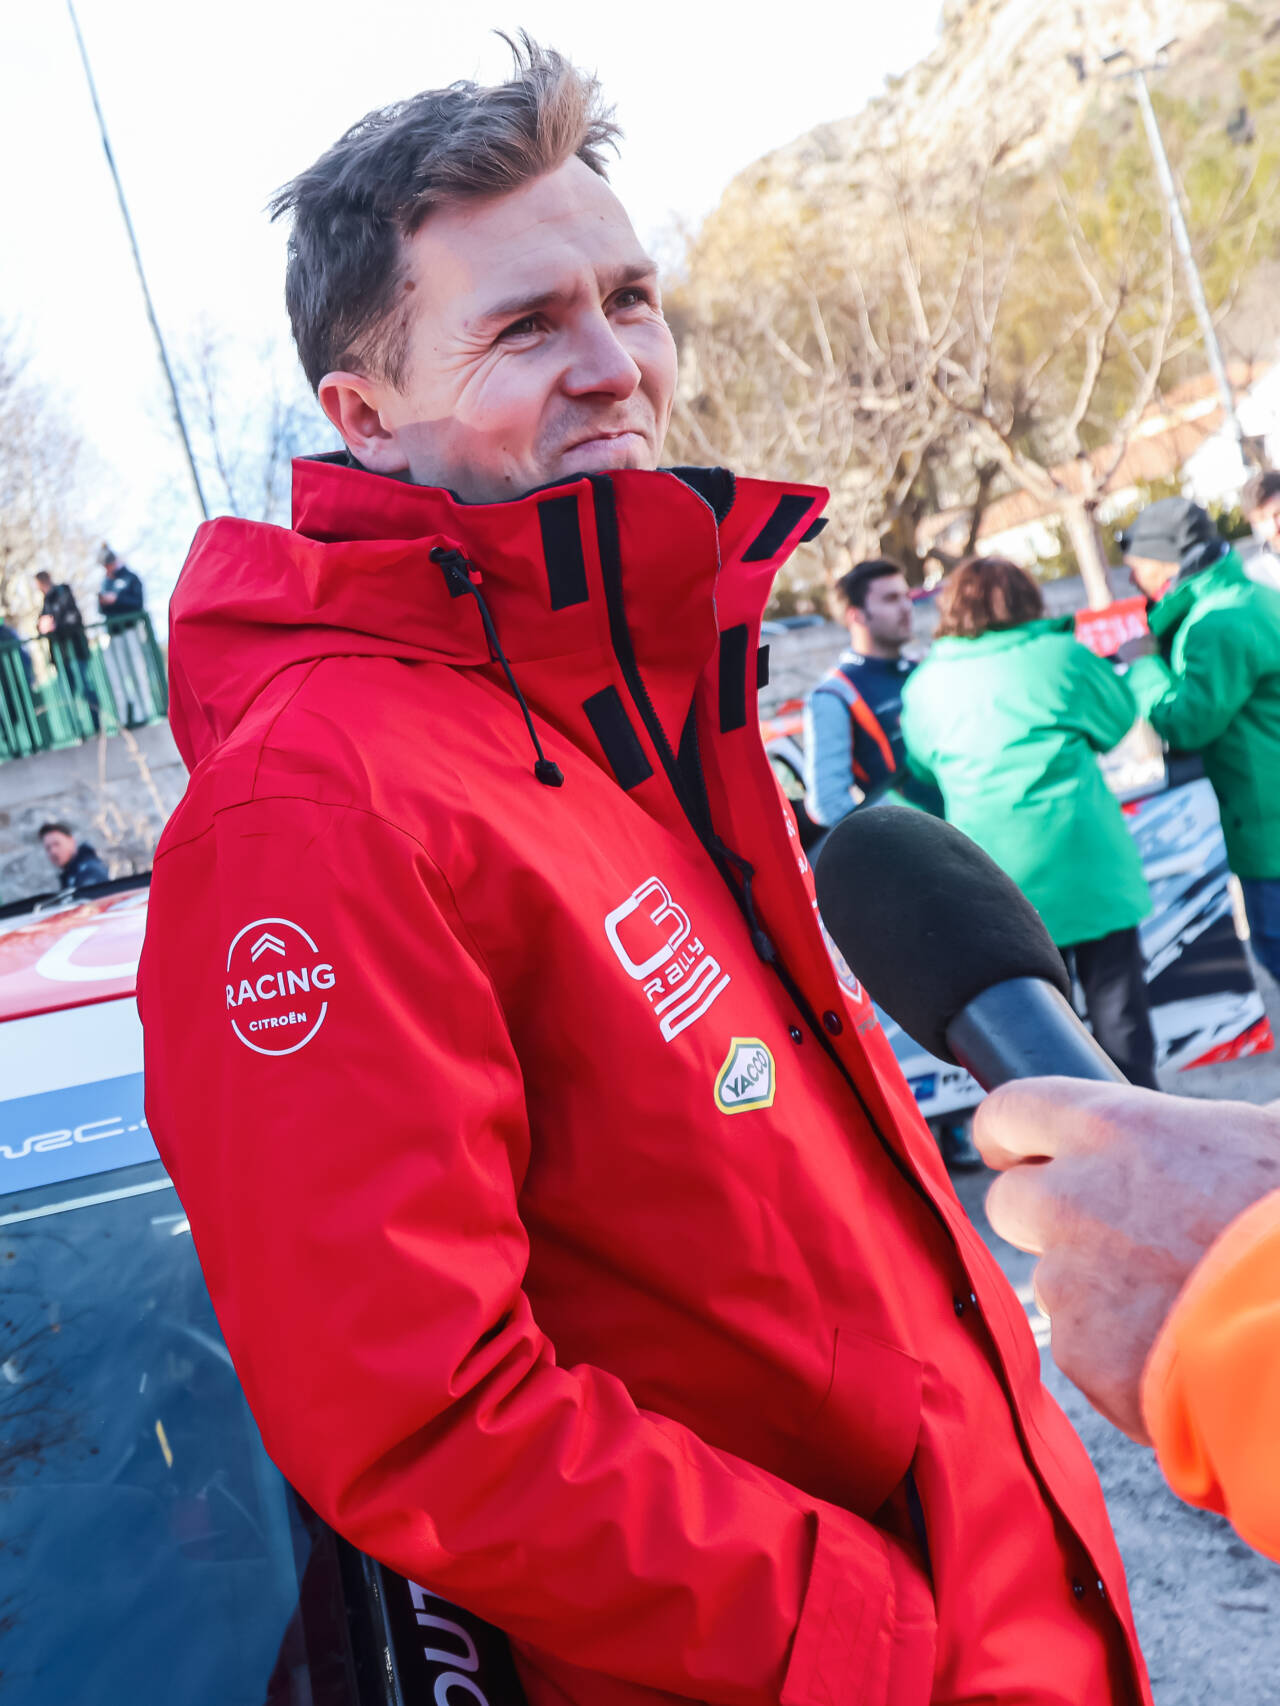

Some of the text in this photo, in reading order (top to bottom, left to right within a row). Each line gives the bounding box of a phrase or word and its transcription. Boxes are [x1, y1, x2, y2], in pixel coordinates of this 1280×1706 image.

[225, 963, 336, 1010] RACING
[248, 1011, 307, 1032] CITROËN
[725, 1050, 768, 1098] YACCO
